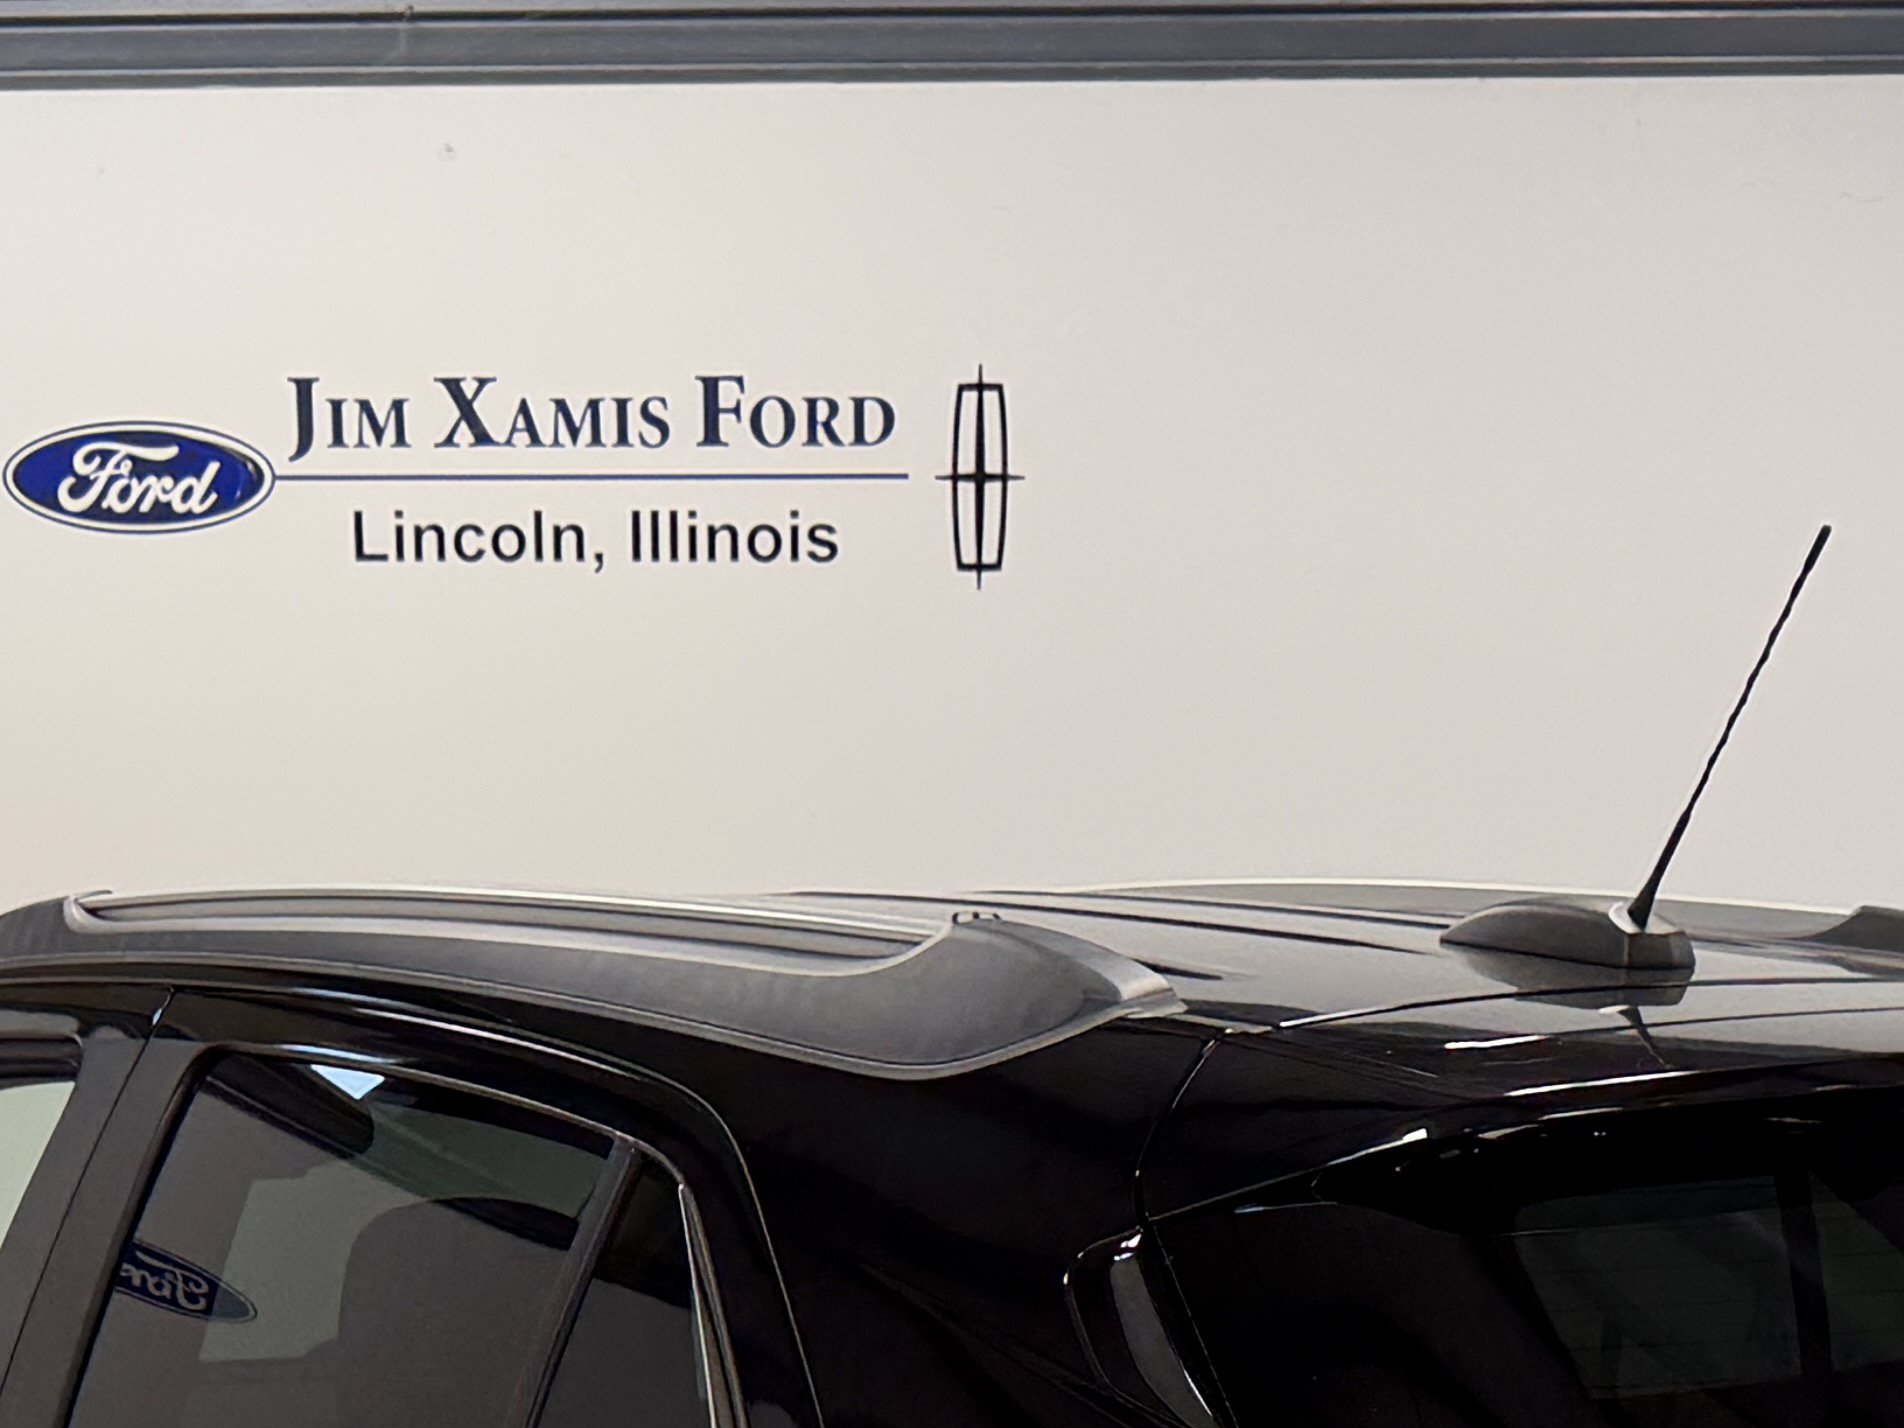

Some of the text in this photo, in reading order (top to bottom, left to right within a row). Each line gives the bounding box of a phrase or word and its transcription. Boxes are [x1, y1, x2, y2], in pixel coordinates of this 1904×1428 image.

[286, 375, 897, 464] JIM XAMIS FORD
[57, 441, 218, 515] Ford
[353, 509, 840, 574] Lincoln, Illinois
